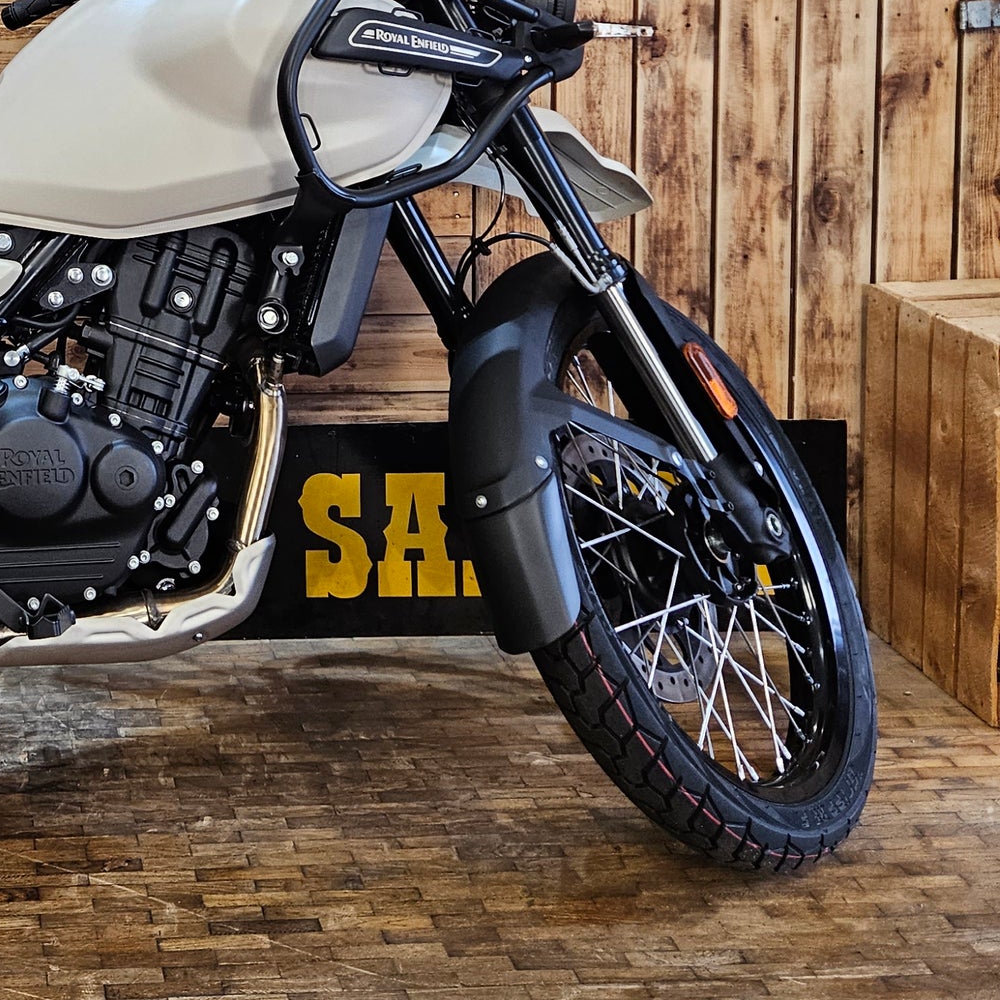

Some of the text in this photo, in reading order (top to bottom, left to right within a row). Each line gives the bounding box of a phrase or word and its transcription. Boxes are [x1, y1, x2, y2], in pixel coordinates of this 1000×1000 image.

[376, 28, 450, 54] ROYAL ENFIELD
[0, 448, 66, 466] ROYAL
[298, 472, 482, 598] SA
